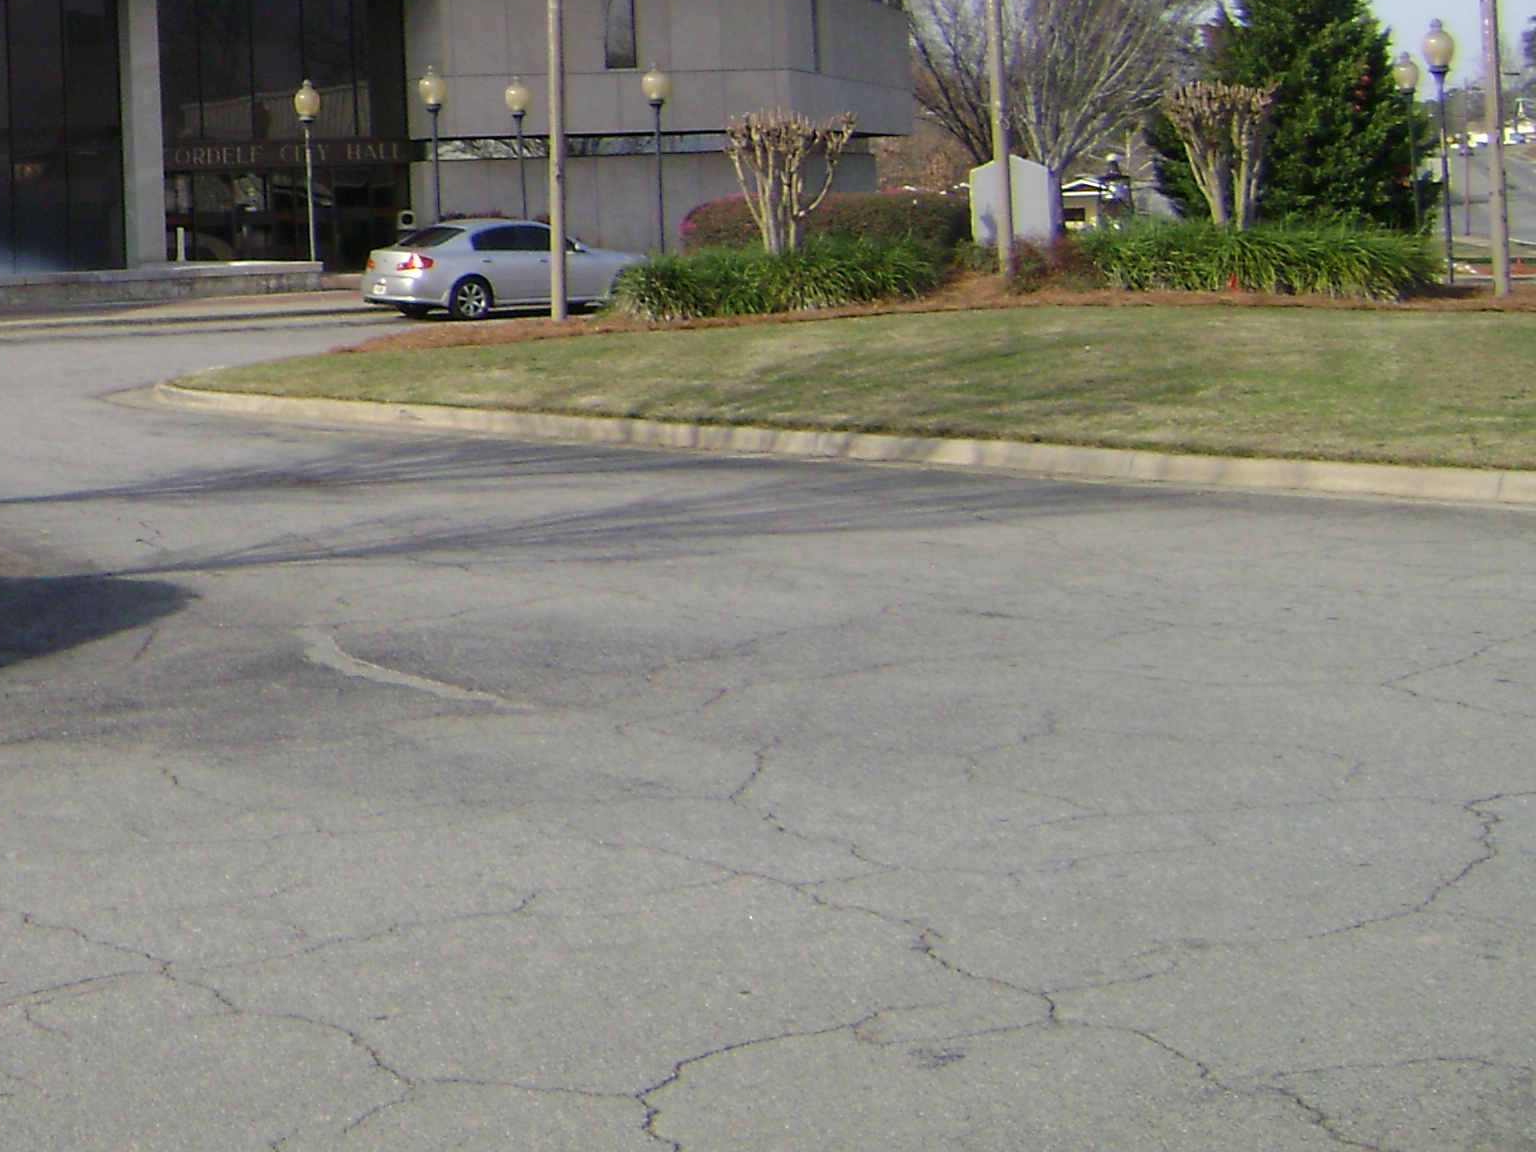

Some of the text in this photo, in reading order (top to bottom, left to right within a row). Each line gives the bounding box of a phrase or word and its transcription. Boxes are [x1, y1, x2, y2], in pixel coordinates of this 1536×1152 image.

[165, 142, 402, 165] ORDELE CIY HALL
